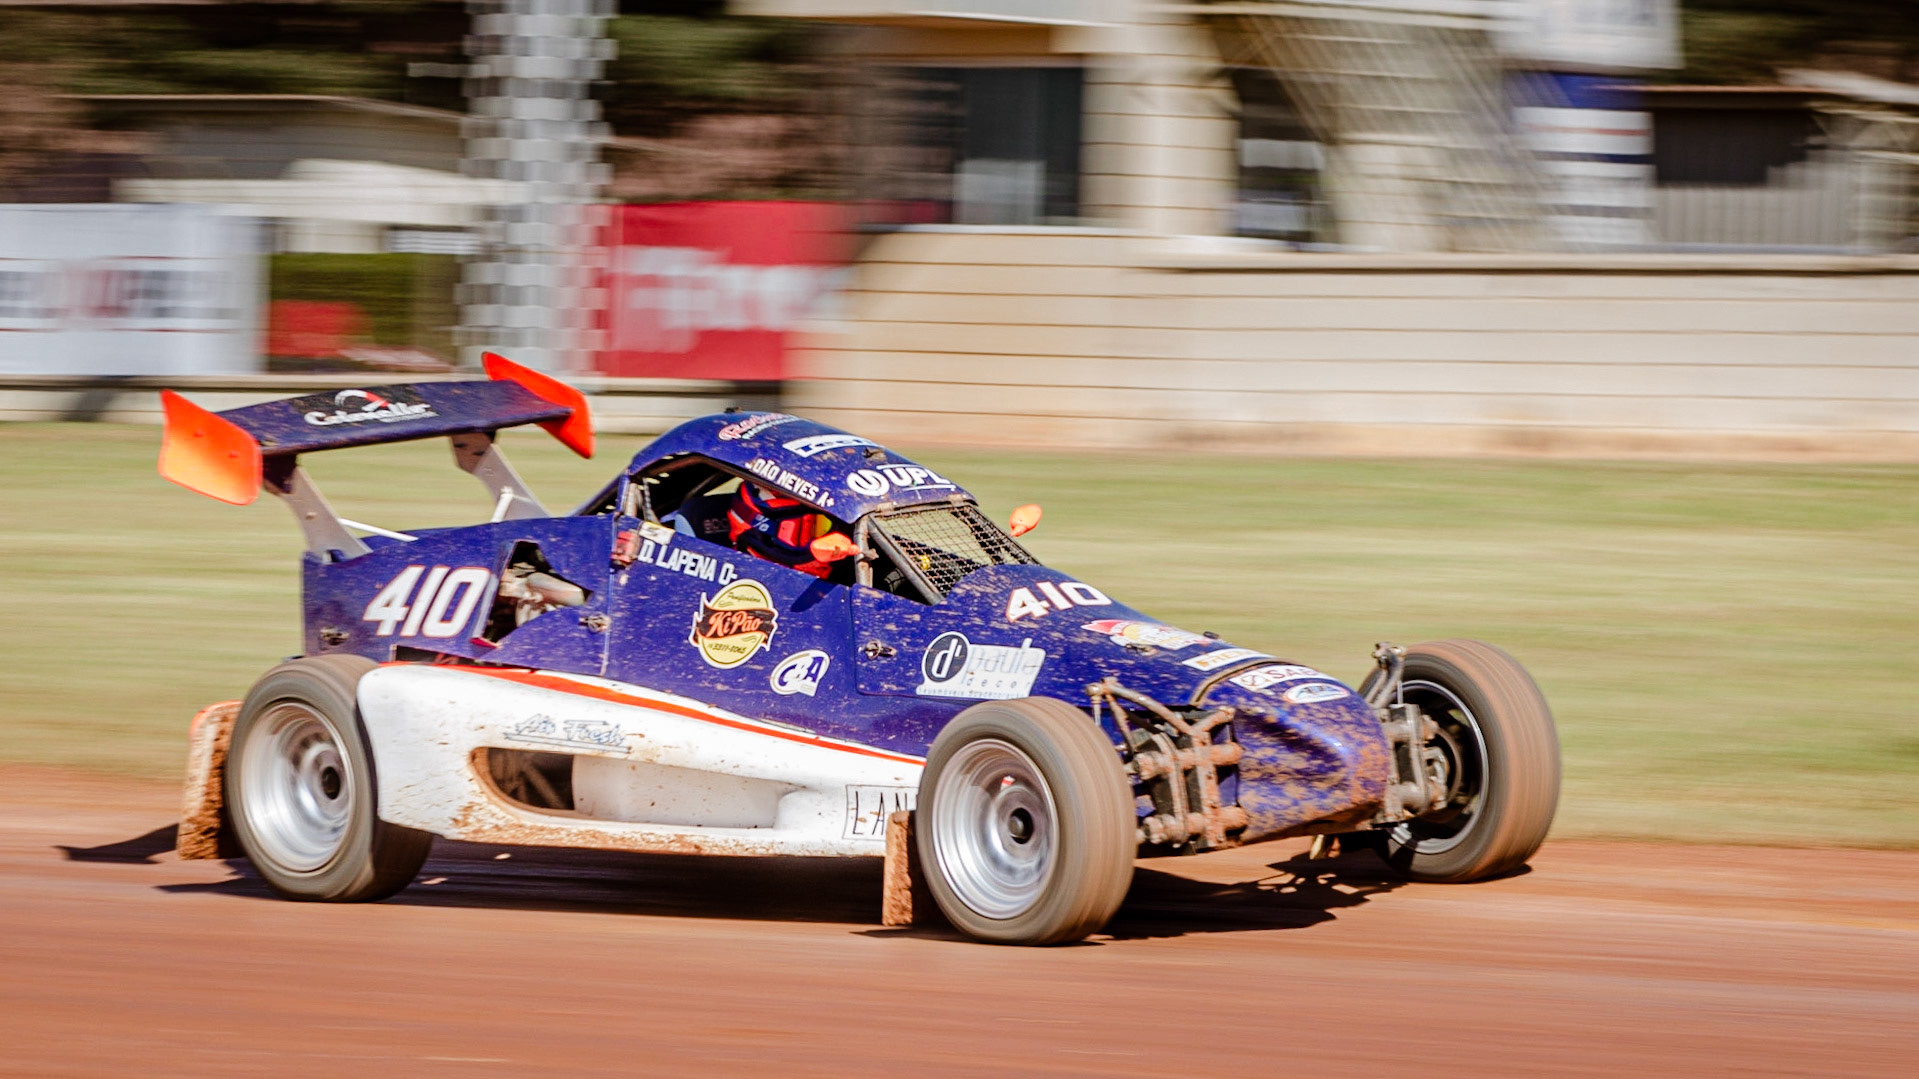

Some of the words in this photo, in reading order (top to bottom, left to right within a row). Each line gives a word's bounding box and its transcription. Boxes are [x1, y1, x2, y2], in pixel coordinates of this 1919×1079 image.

[777, 469, 819, 500] NEVES
[816, 491, 835, 508] A+
[883, 467, 951, 487] UPL
[655, 544, 717, 583] LAPENA
[362, 564, 492, 638] 410
[1005, 581, 1112, 623] 410
